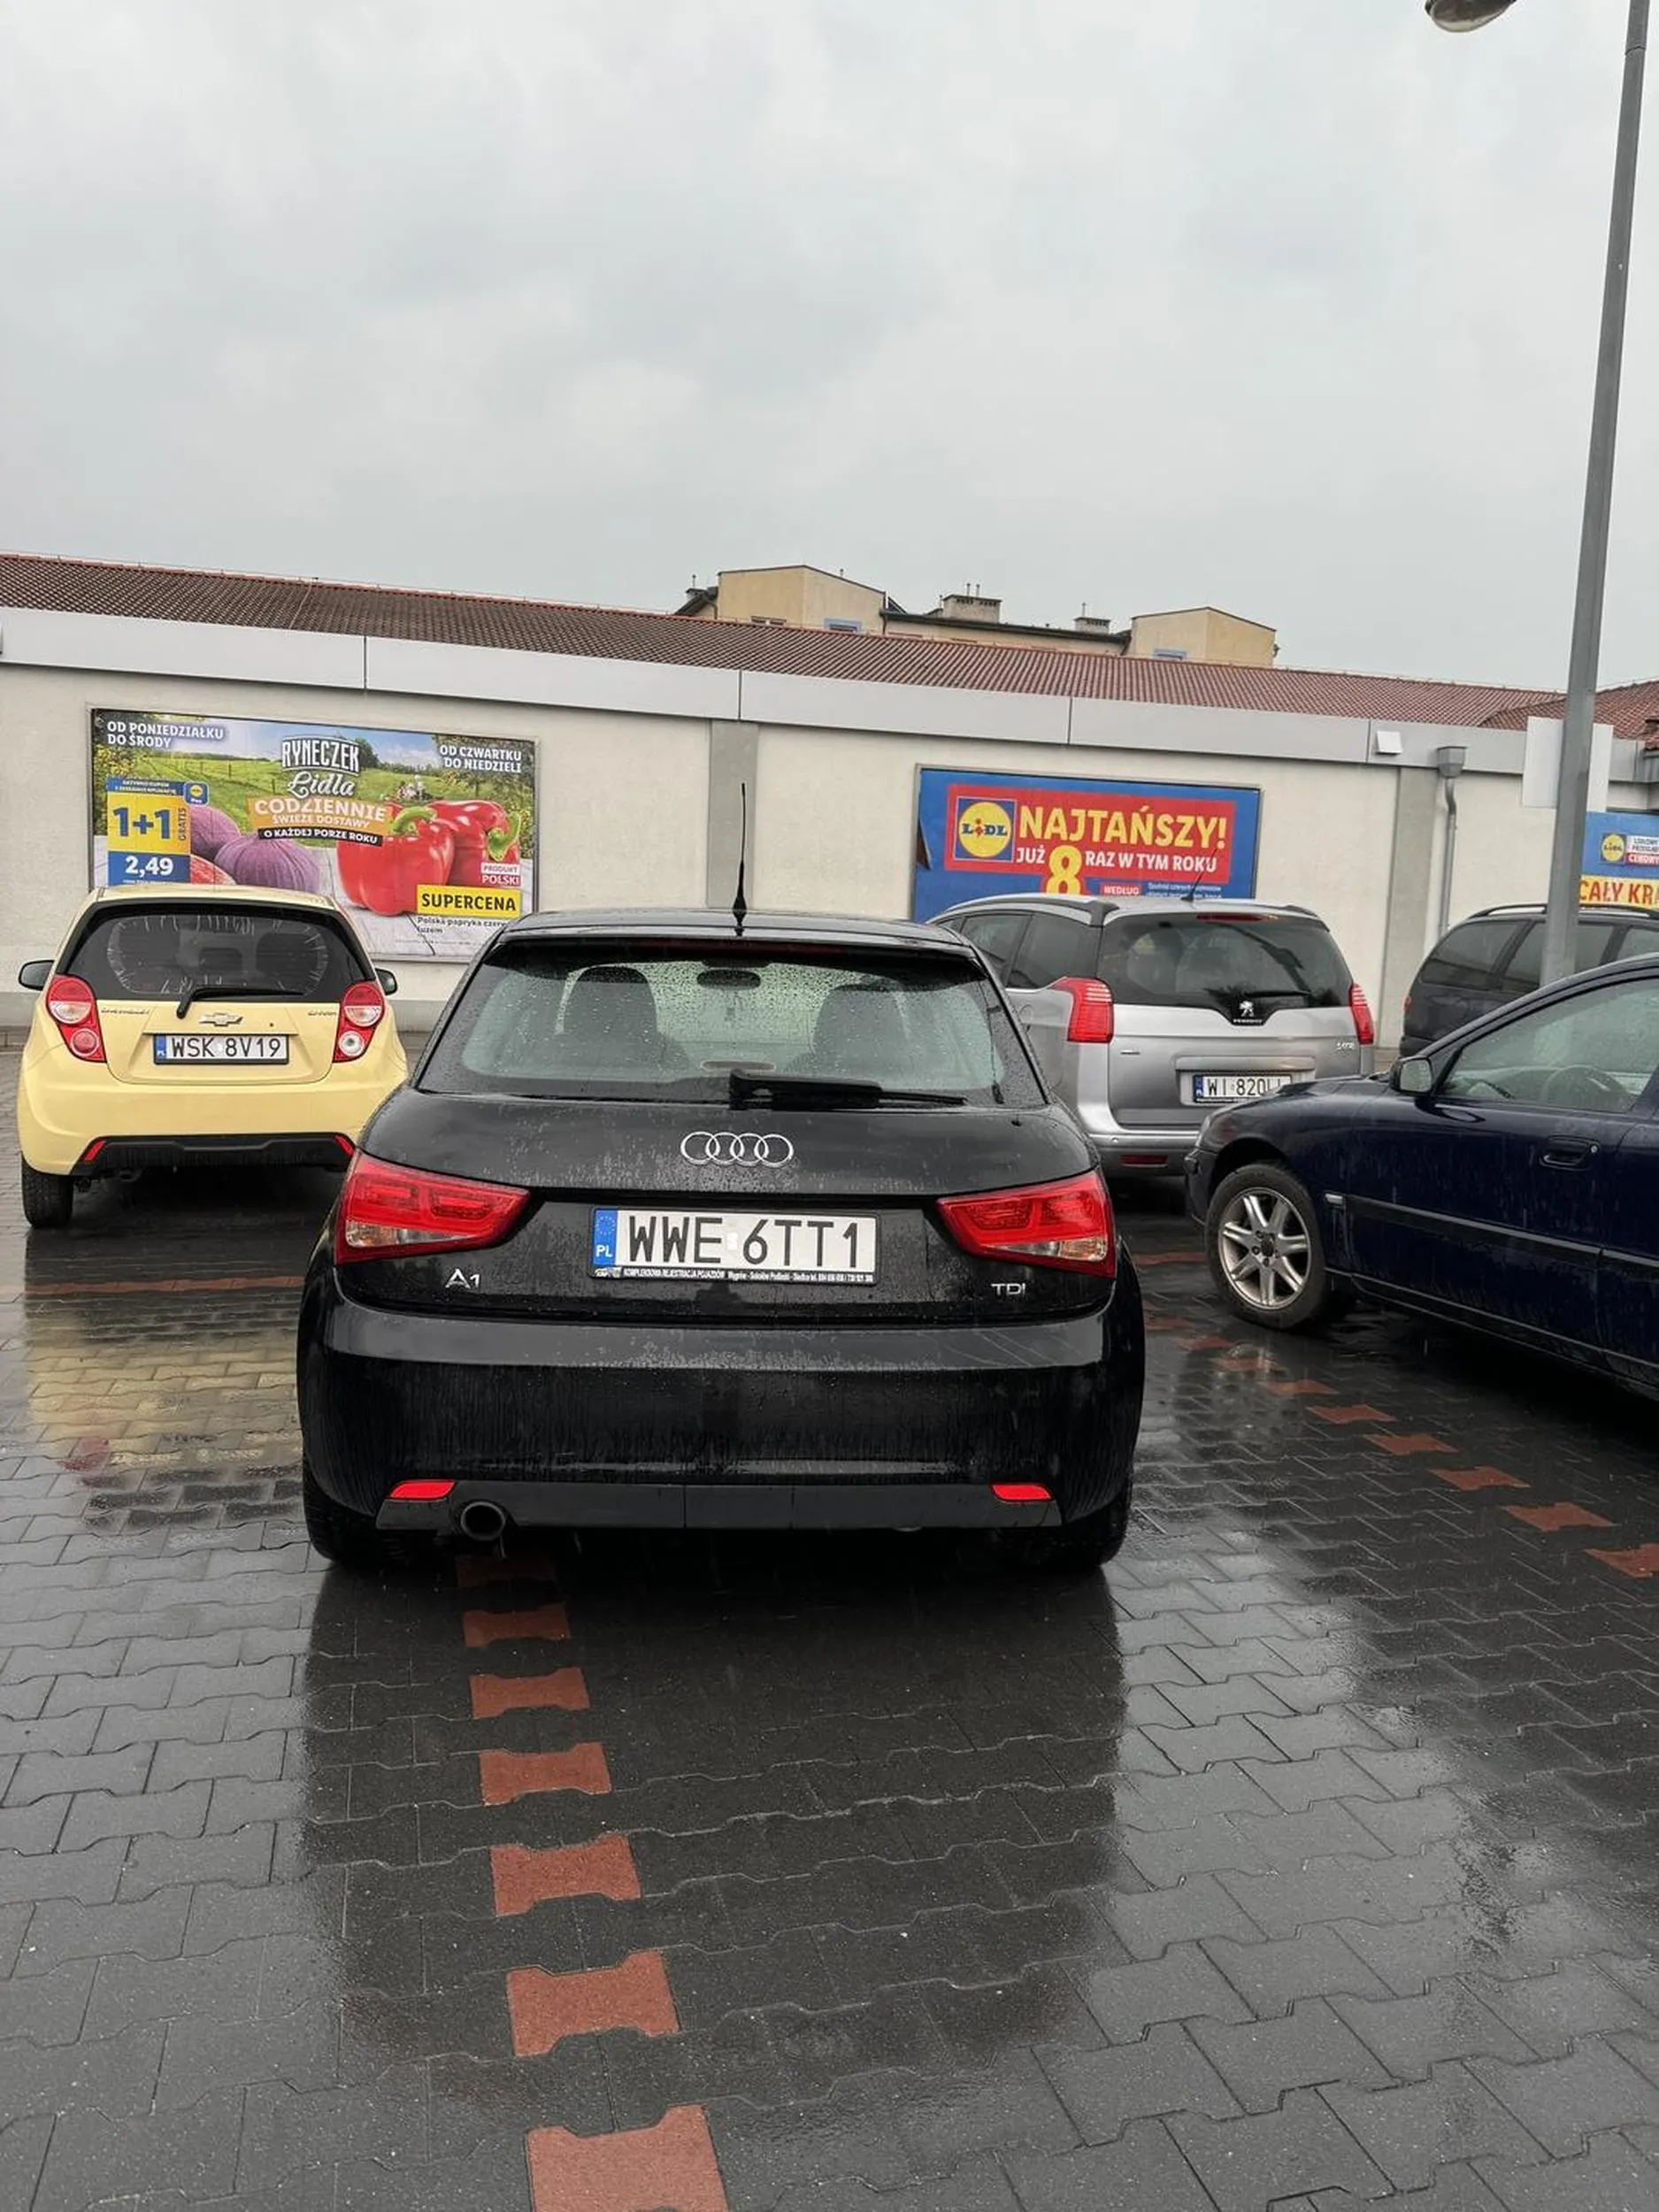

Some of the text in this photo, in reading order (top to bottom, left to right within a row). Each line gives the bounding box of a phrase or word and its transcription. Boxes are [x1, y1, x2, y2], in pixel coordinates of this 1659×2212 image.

[107, 721, 224, 740] OD PONIEDZIAŁKU
[107, 732, 172, 748] DO ŚRODY
[282, 739, 359, 772] RYNECZEK
[440, 745, 522, 761] OD CZWARTKU
[444, 757, 521, 773] DO NIEDZIELI
[287, 771, 356, 799] Lidla
[254, 798, 388, 822] CODZIENNIE
[112, 807, 171, 839] 1+1
[1018, 804, 1227, 849] NAJTAŃSZY!
[275, 827, 312, 837] KAŻDEJ
[314, 829, 348, 839] PORZE
[349, 833, 379, 844] ROKU
[125, 855, 174, 878] 2,49
[1016, 844, 1217, 895] JUŻ 8 RAZ W TYM ROKU
[482, 875, 519, 885] POLSKI
[421, 893, 517, 911] SUPERCENA
[1629, 883, 1659, 905] KR
[172, 1037, 281, 1057] WSK 8V19
[595, 1245, 613, 1258] PL
[629, 1217, 858, 1268] WWE 6TT1
[445, 1268, 480, 1288] A1
[991, 1283, 1025, 1296] TDI
